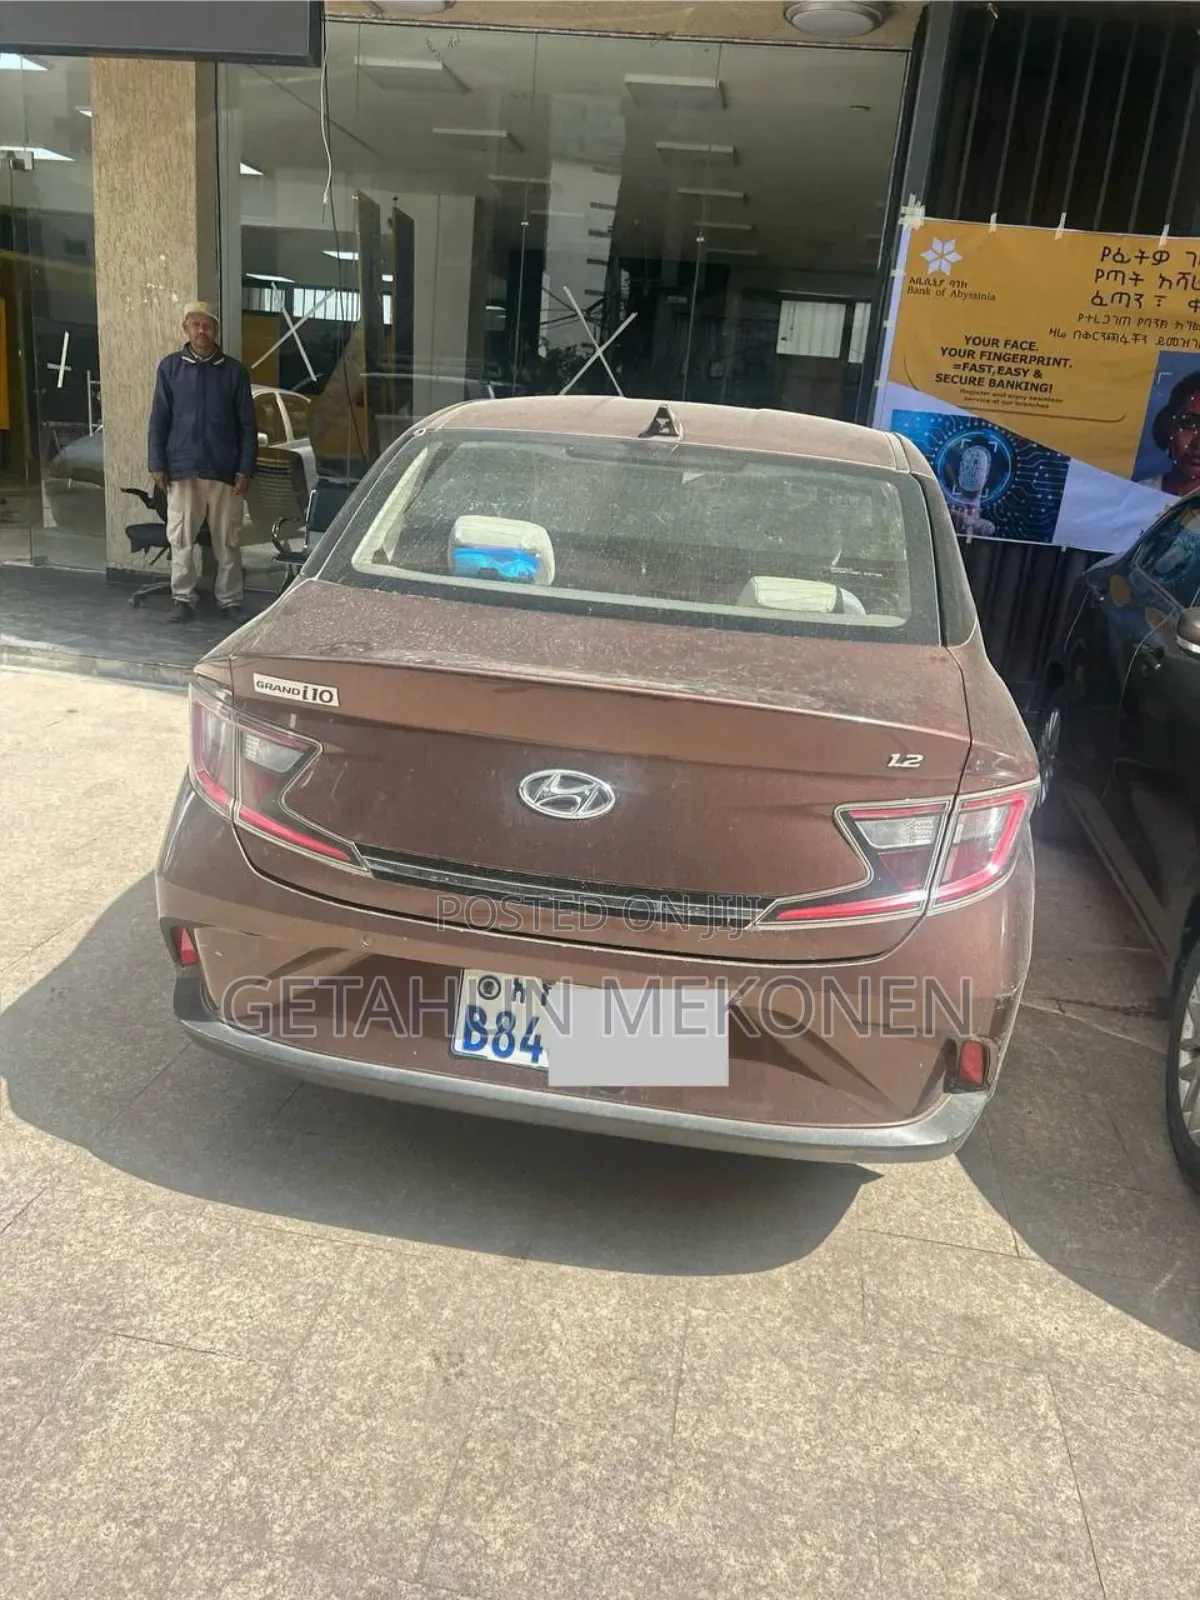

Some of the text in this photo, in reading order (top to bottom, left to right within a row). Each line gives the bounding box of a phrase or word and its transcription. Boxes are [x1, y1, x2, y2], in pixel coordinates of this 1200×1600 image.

[907, 285, 996, 301] Bank of Abyssinia
[963, 334, 1000, 349] YOUR
[940, 346, 976, 360] YOUR
[1032, 369, 1043, 380] &
[935, 372, 1054, 394] SECURE BANKING!
[255, 680, 334, 703] GRAND i10
[462, 1004, 545, 1063] B84
